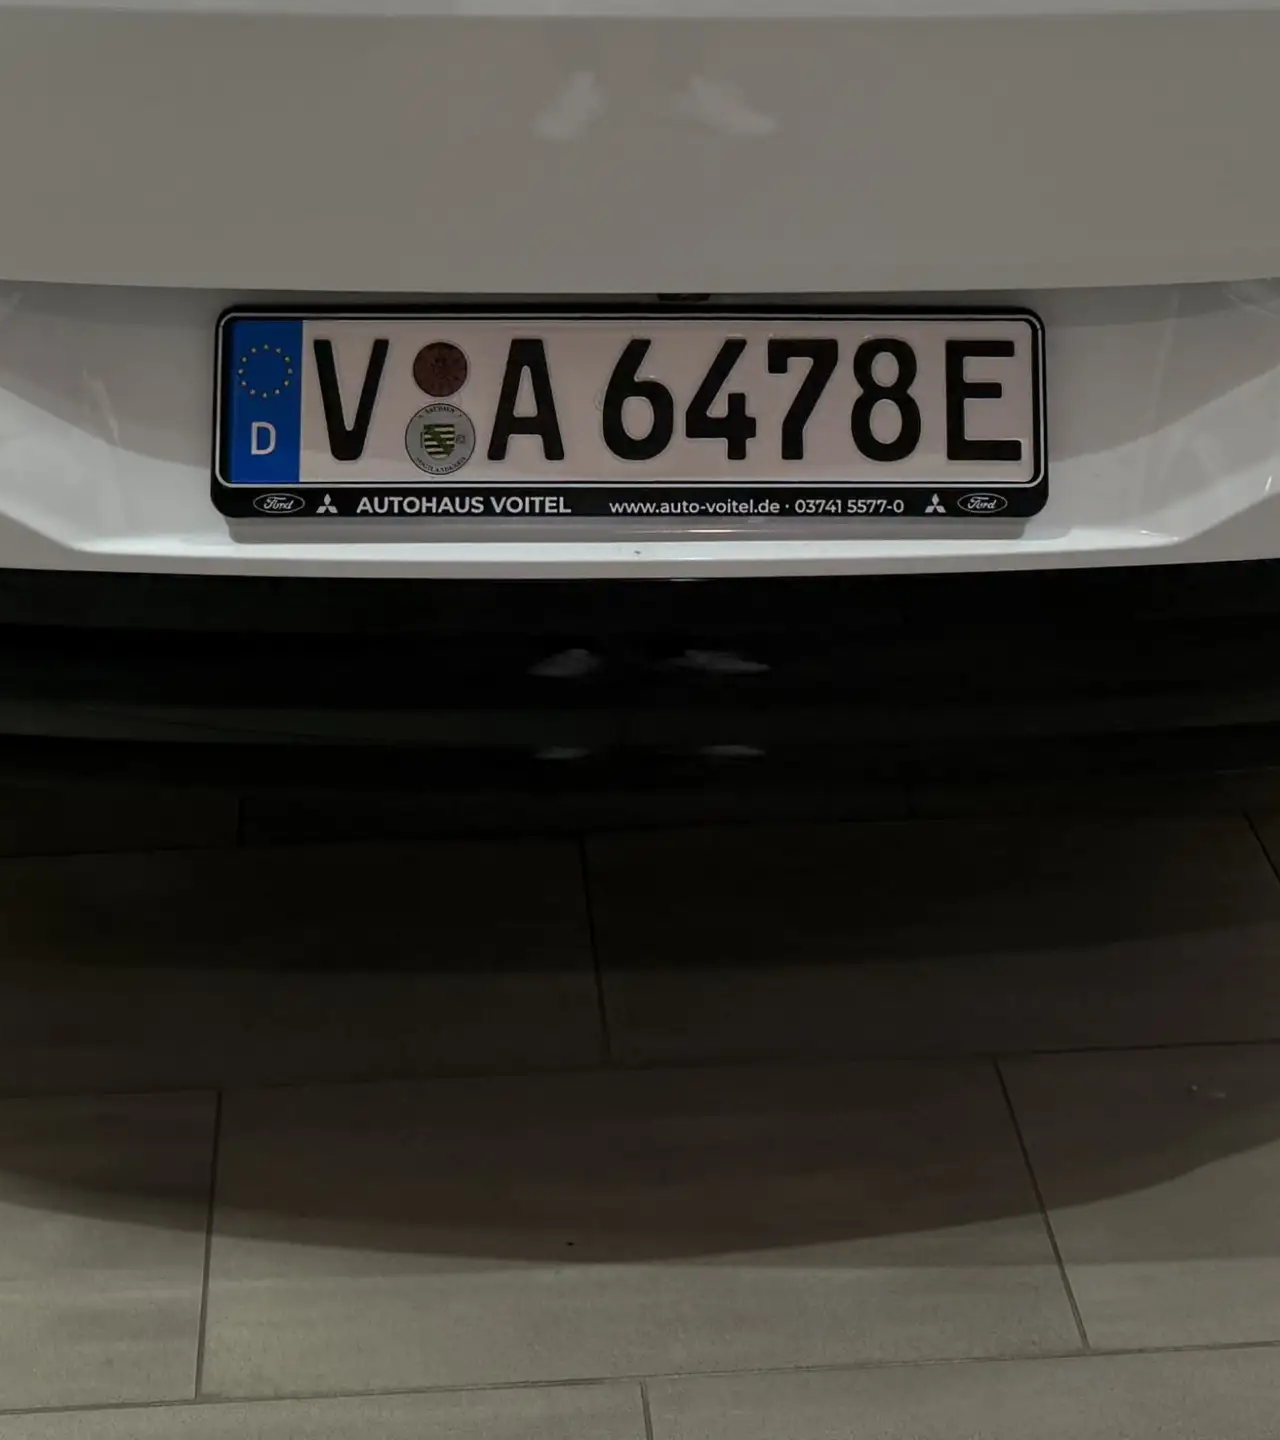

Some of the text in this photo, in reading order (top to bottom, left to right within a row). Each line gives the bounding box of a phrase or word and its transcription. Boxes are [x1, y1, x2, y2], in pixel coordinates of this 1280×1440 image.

[313, 338, 389, 461] V
[602, 338, 1024, 461] 6478E
[250, 421, 277, 455] D
[356, 496, 572, 514] AUTOHAUS VOITEL
[609, 499, 905, 514] www.auto-voitel.de 03741 5577-0
